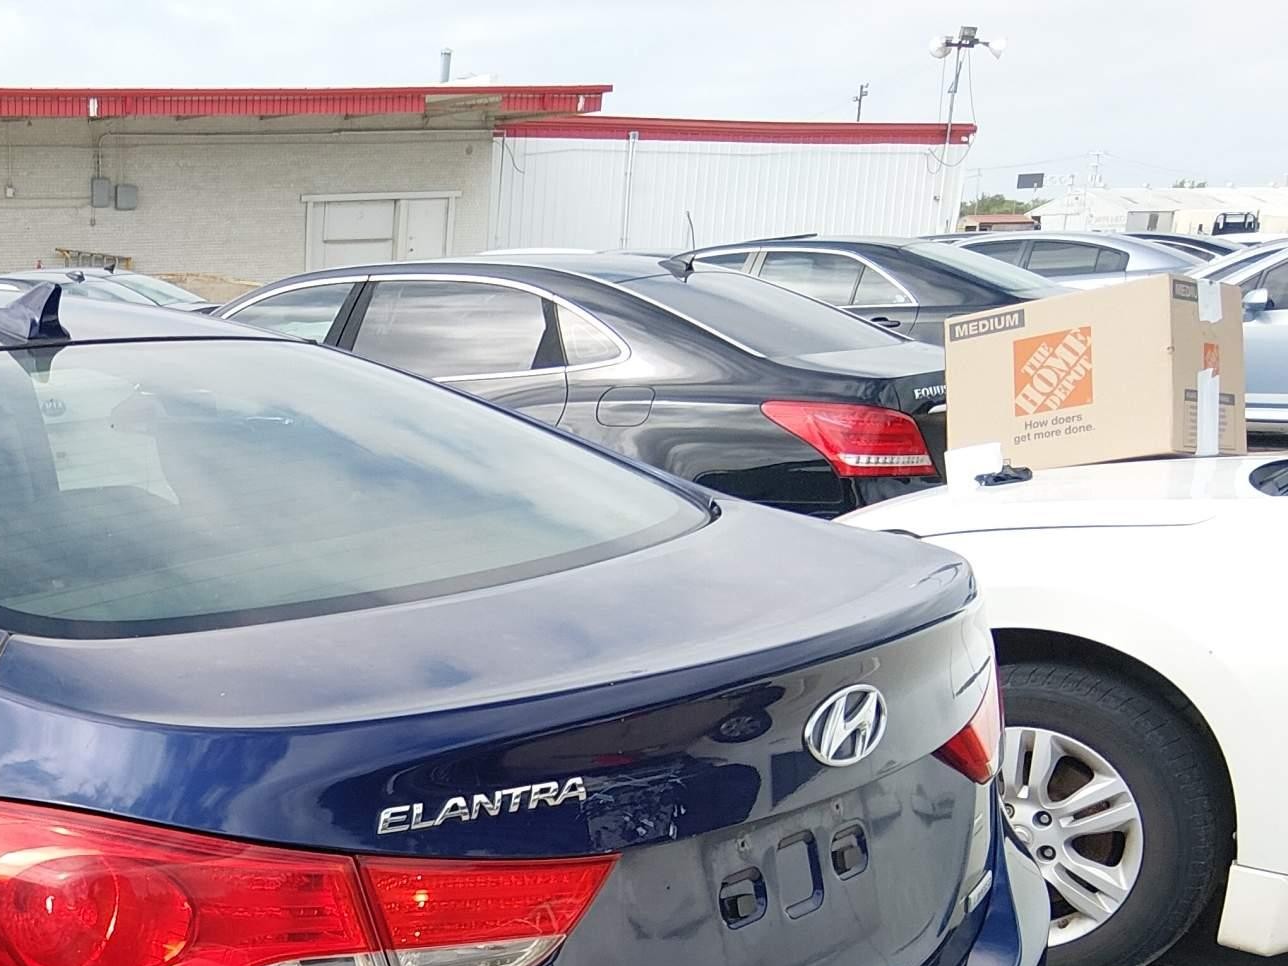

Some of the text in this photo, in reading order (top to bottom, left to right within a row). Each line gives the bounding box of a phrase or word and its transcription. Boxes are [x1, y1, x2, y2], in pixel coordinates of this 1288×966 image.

[955, 312, 1019, 338] MEDIUM
[1015, 328, 1092, 415] HOME
[1021, 341, 1054, 377] THE
[1044, 355, 1092, 410] DEPOT
[1014, 422, 1096, 445] get more done.
[1024, 414, 1083, 430] How doers
[377, 776, 587, 835] ELANTRA
